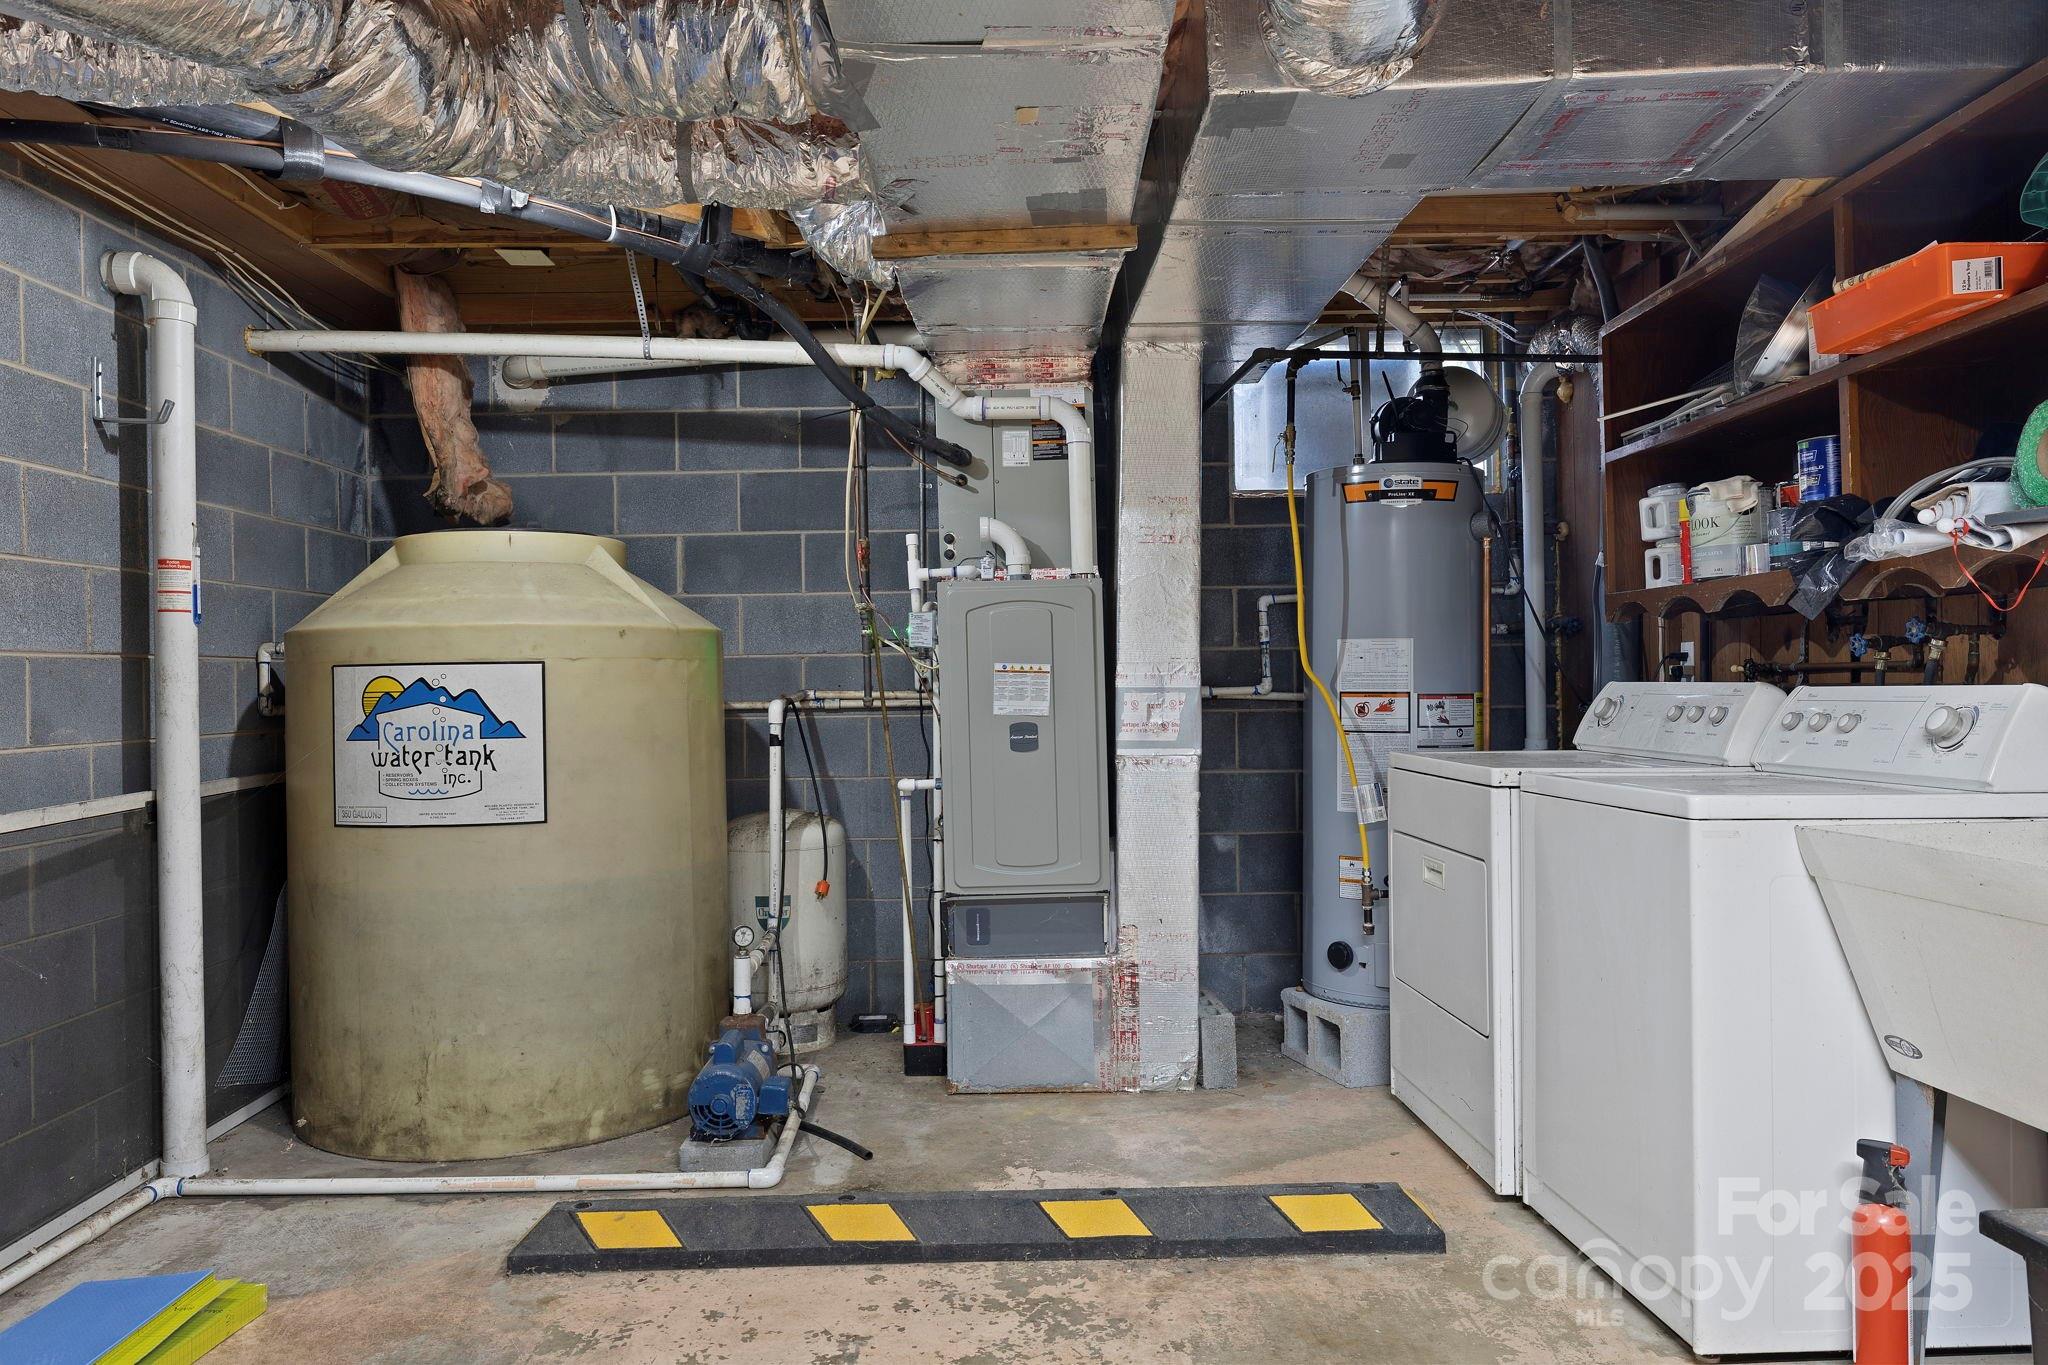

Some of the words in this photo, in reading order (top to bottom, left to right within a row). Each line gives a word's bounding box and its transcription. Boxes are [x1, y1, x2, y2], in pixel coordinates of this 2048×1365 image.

[383, 720, 474, 751] Carolina
[372, 745, 434, 774] water
[445, 744, 497, 772] tank
[443, 770, 471, 788] inc.
